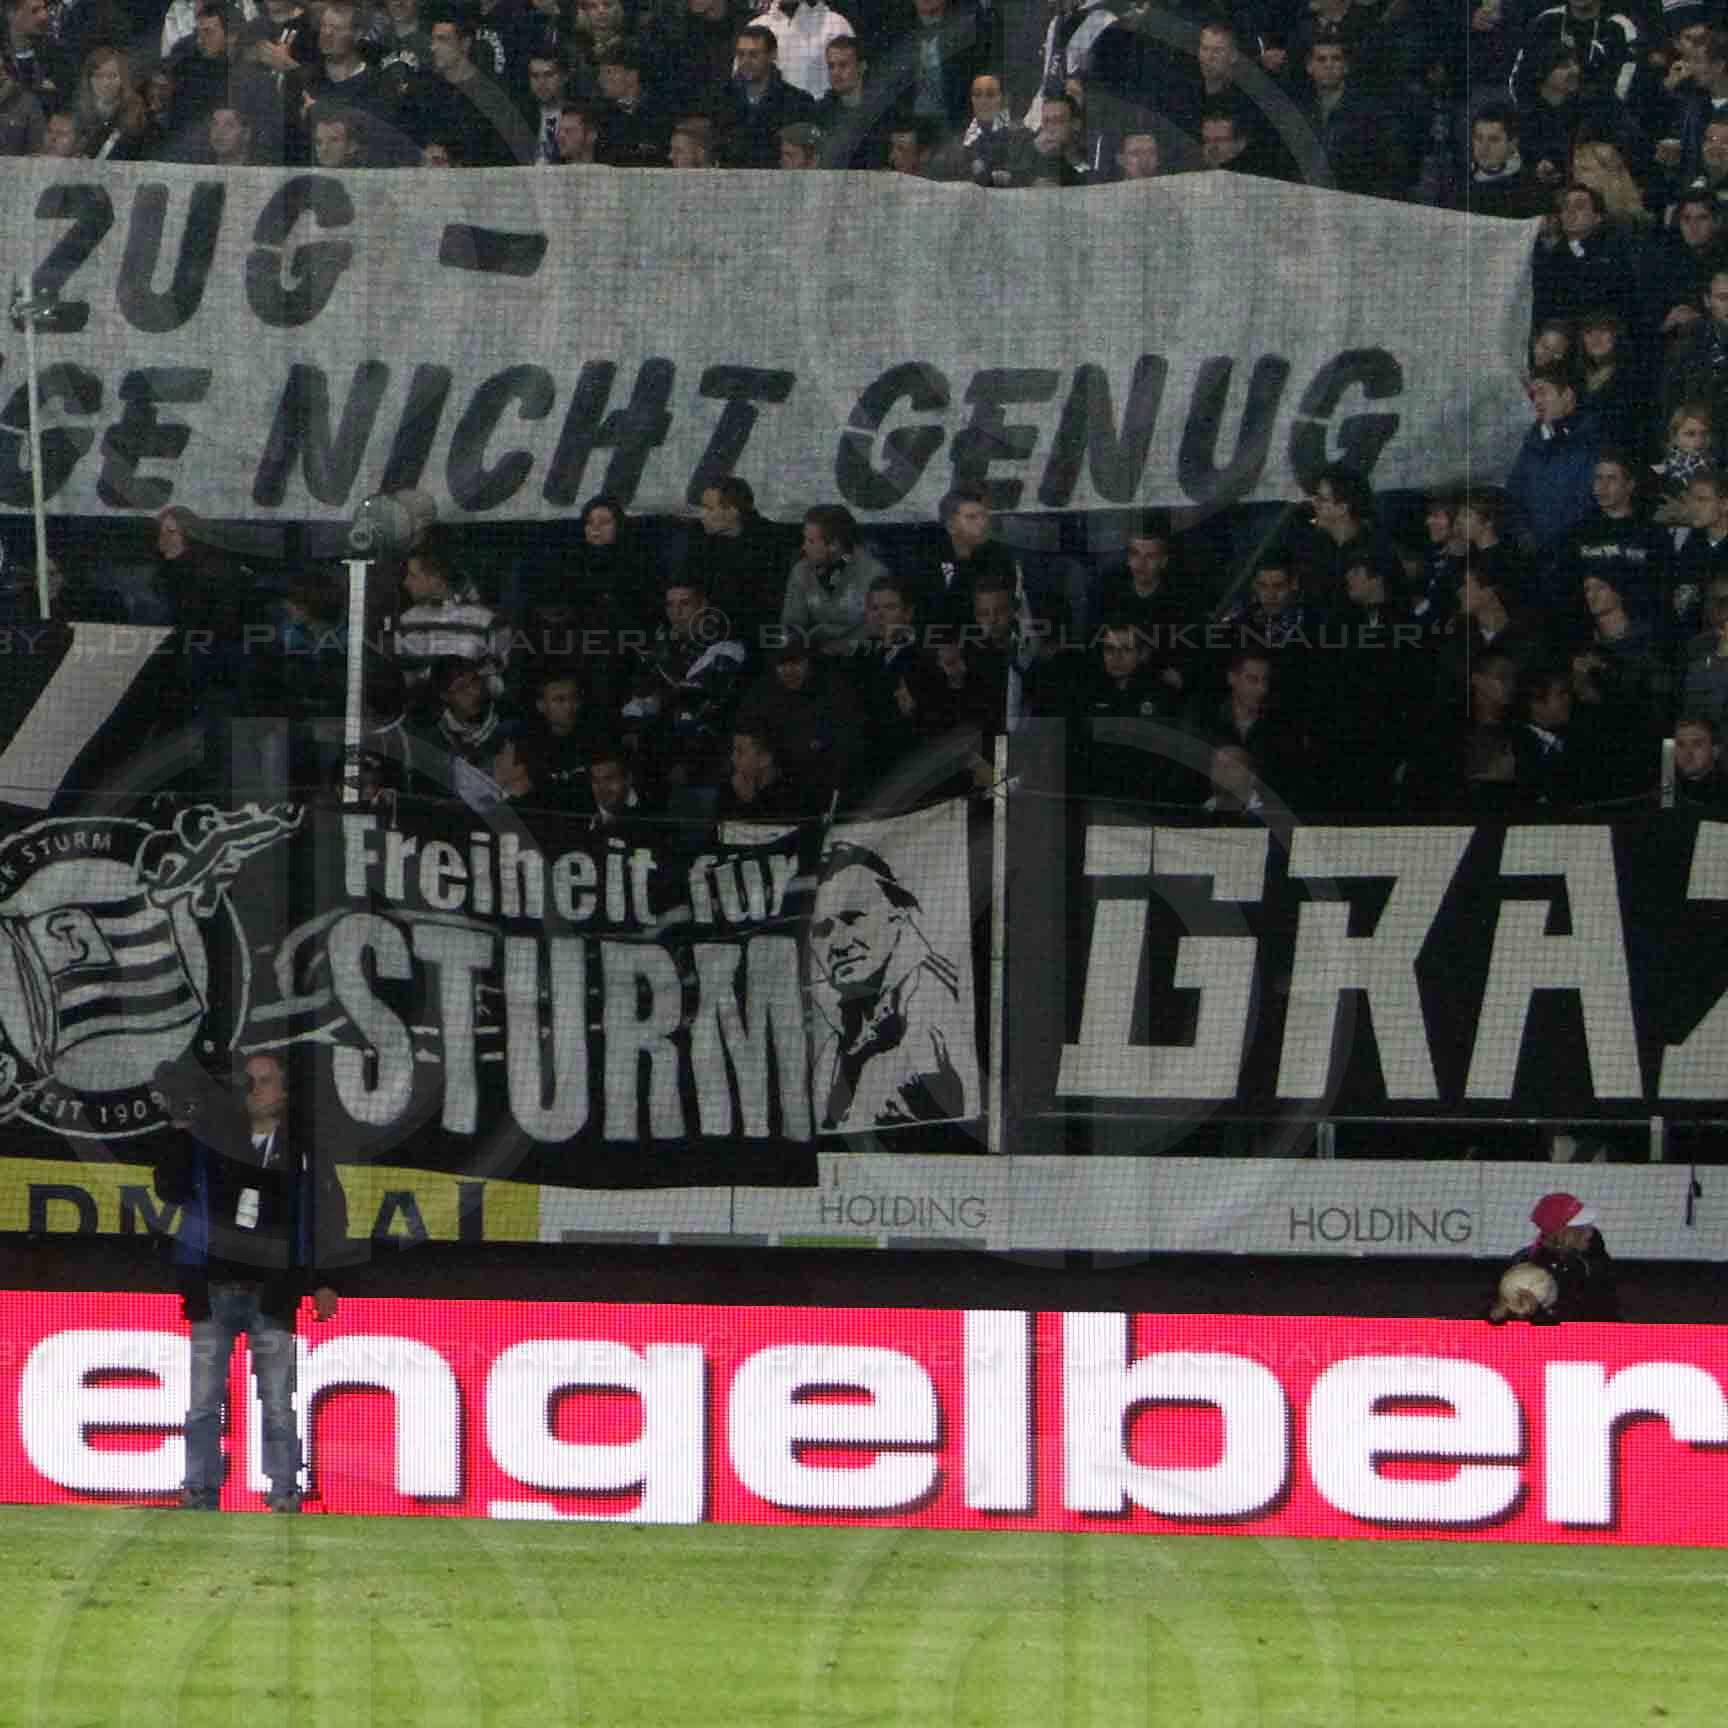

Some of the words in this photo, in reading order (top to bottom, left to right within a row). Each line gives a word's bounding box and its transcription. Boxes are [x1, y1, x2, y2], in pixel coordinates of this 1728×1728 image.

[30, 172, 355, 336] ZUG
[252, 358, 796, 514] NICHT
[836, 346, 1405, 513] GENUG
[20, 831, 113, 863] STURM
[343, 810, 657, 926] Freiheit
[328, 910, 813, 1142] STURM
[818, 1194, 988, 1228] HOLDING
[1289, 1205, 1473, 1244] HOLDING
